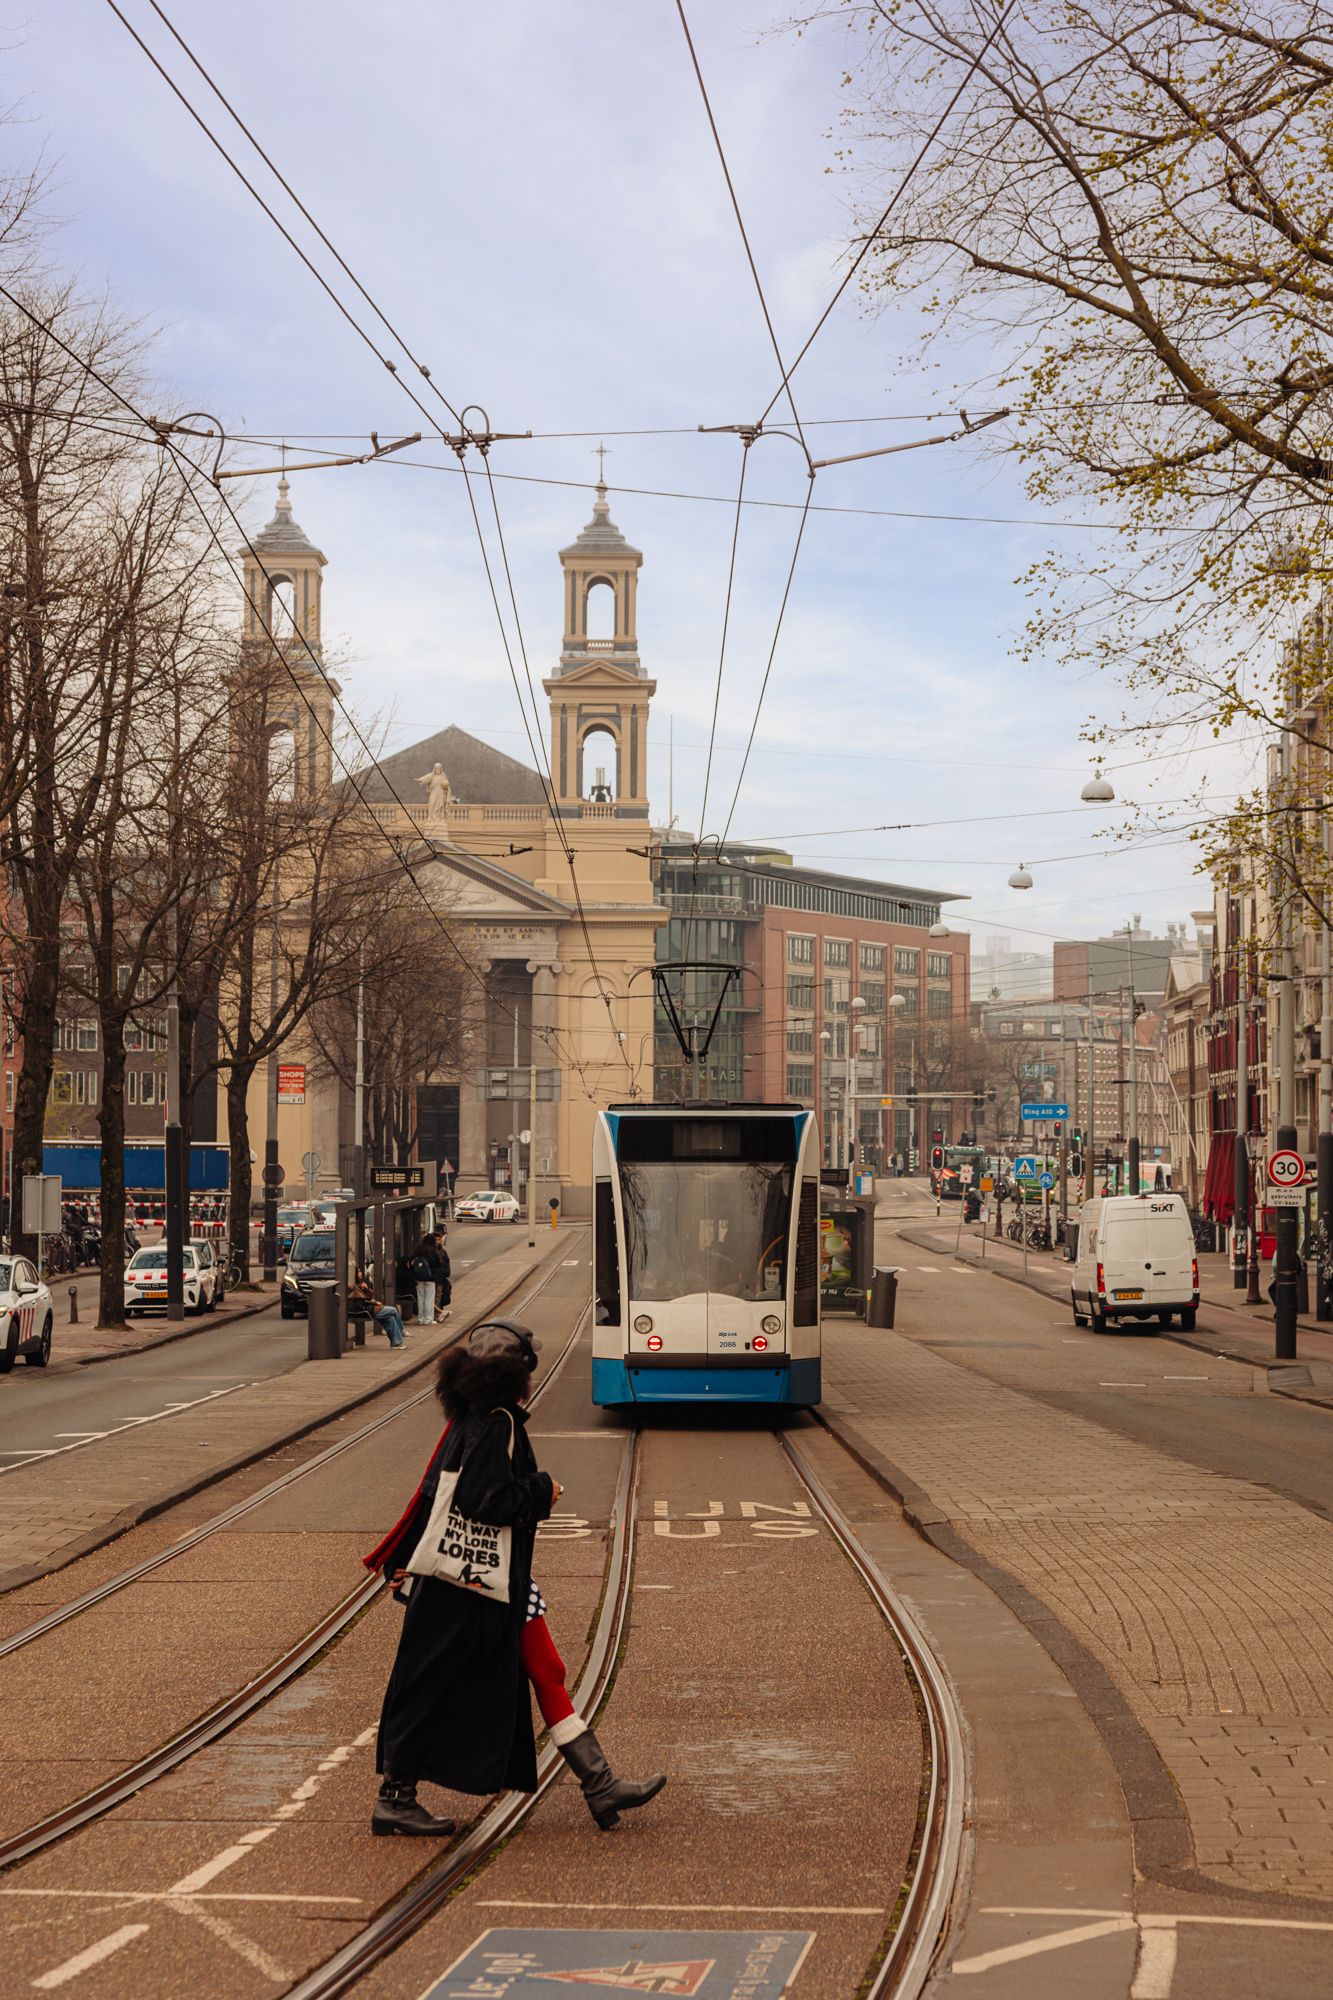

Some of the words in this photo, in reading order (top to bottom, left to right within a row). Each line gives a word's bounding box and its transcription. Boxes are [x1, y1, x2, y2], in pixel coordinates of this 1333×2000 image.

[1276, 1162, 1298, 1175] 30
[448, 1516, 467, 1532] THE
[471, 1525, 501, 1539] WAY
[444, 1528, 463, 1542] MY
[465, 1536, 498, 1551] LORE
[438, 1538, 500, 1568] LORES
